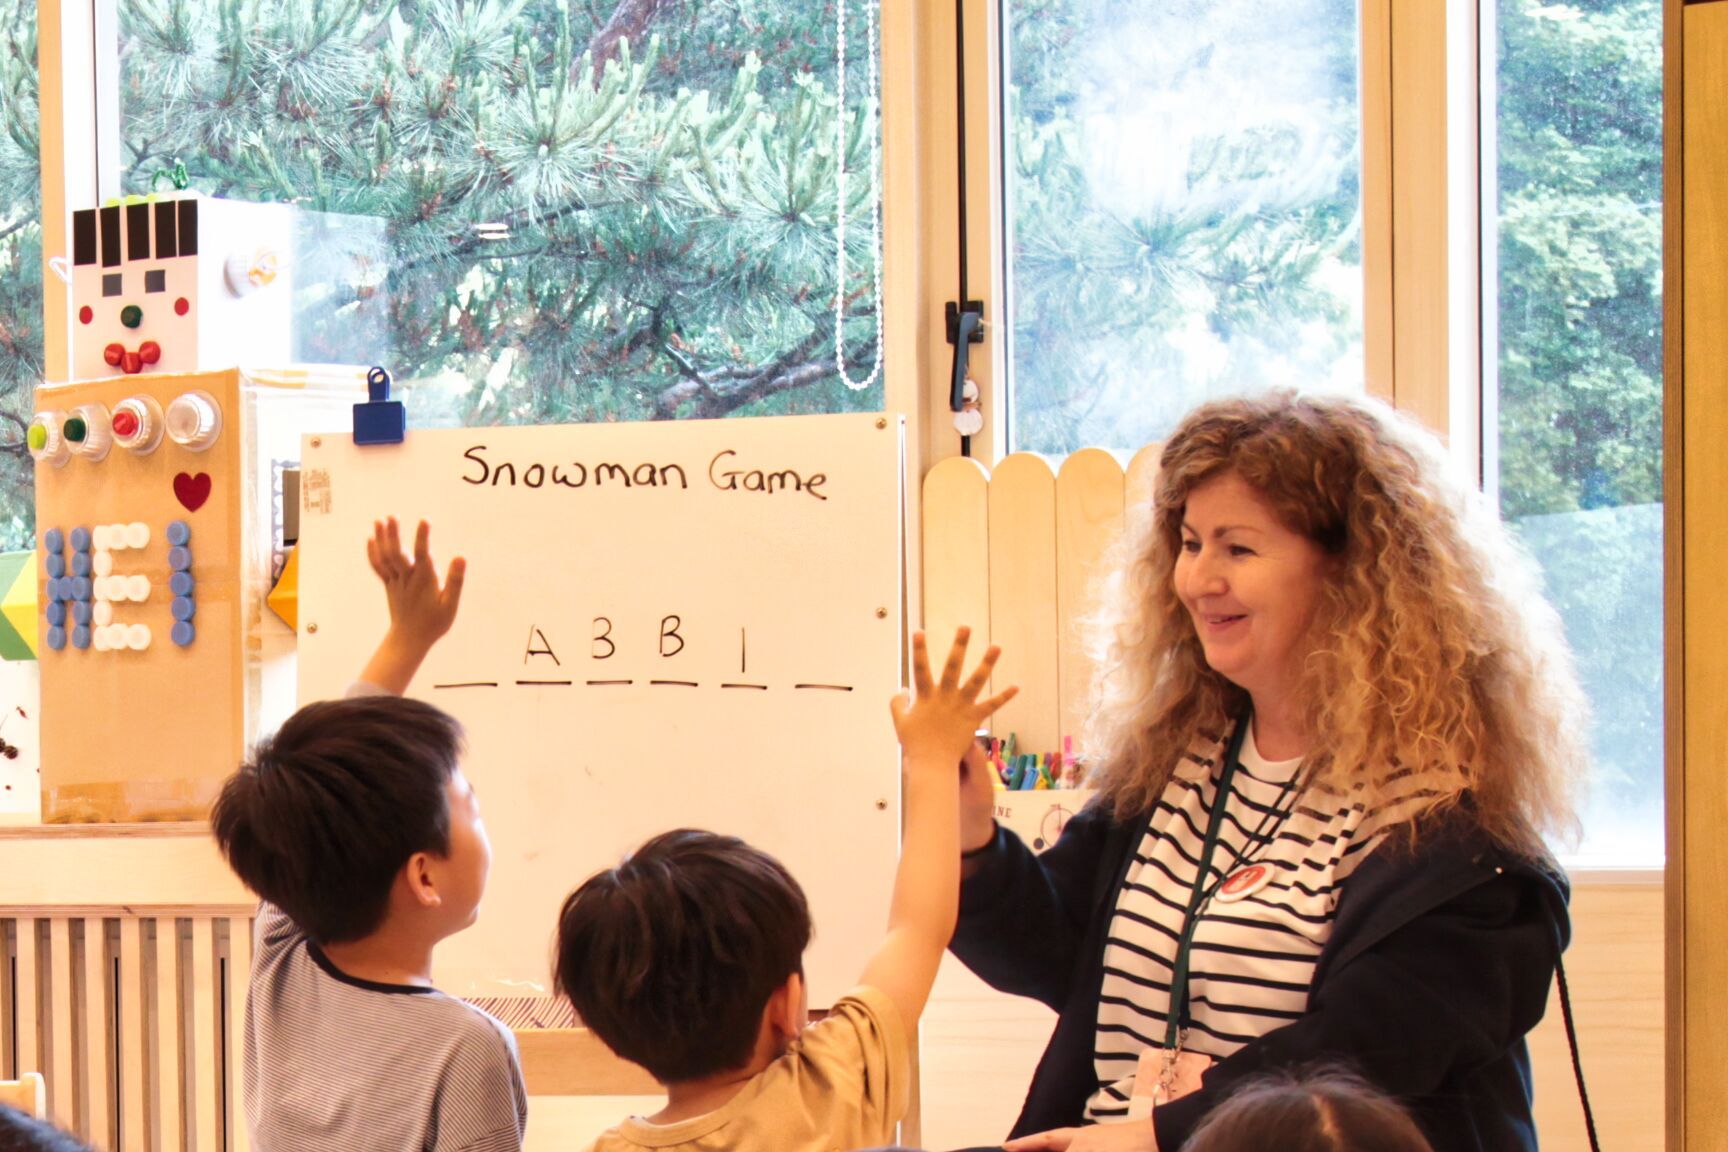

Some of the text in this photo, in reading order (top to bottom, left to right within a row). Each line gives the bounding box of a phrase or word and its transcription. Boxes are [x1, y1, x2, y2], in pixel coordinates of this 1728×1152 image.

[461, 444, 829, 502] Snowman Game
[524, 625, 561, 667] A
[658, 614, 685, 658] B
